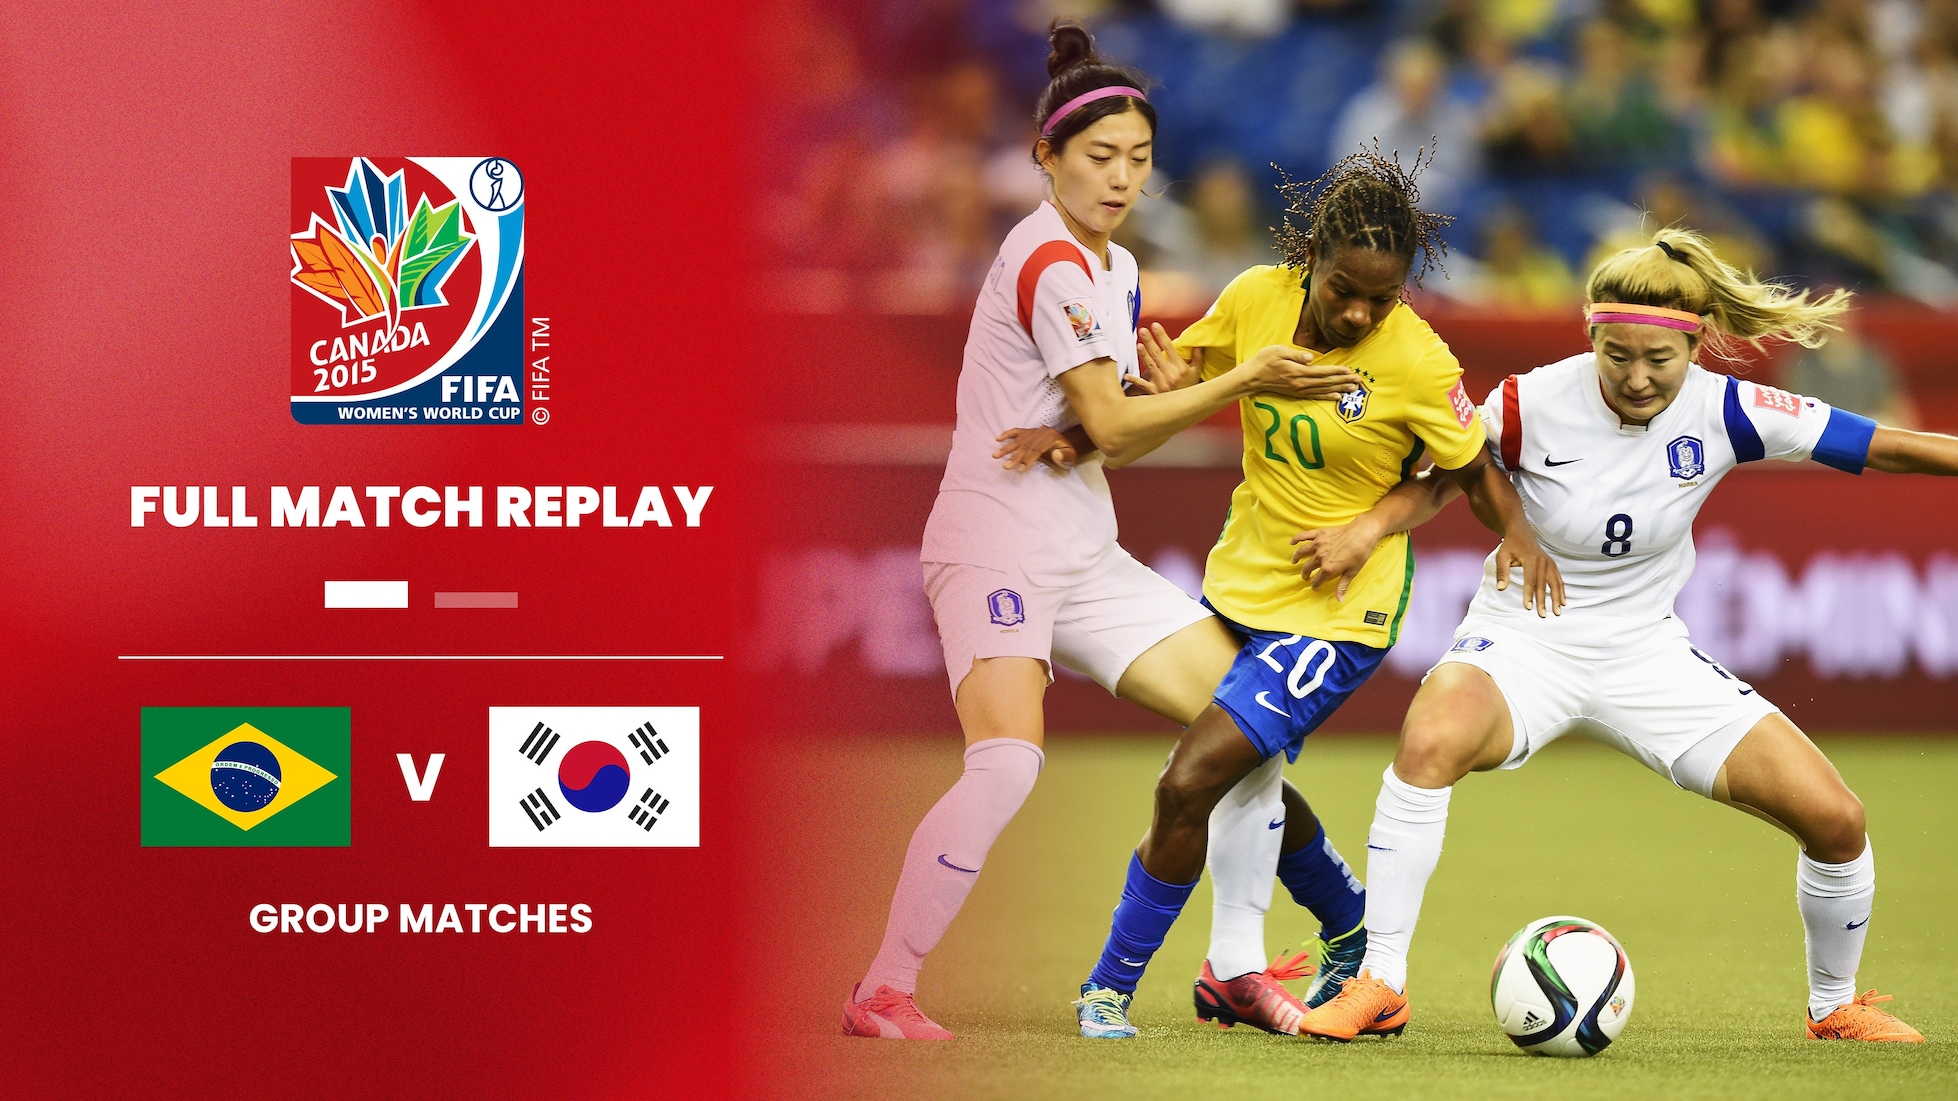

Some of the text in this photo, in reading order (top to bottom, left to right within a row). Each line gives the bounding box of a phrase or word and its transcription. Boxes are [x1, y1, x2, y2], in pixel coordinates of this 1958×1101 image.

[1254, 402, 1325, 470] 20
[1601, 513, 1633, 557] 8
[1256, 634, 1337, 699] 20
